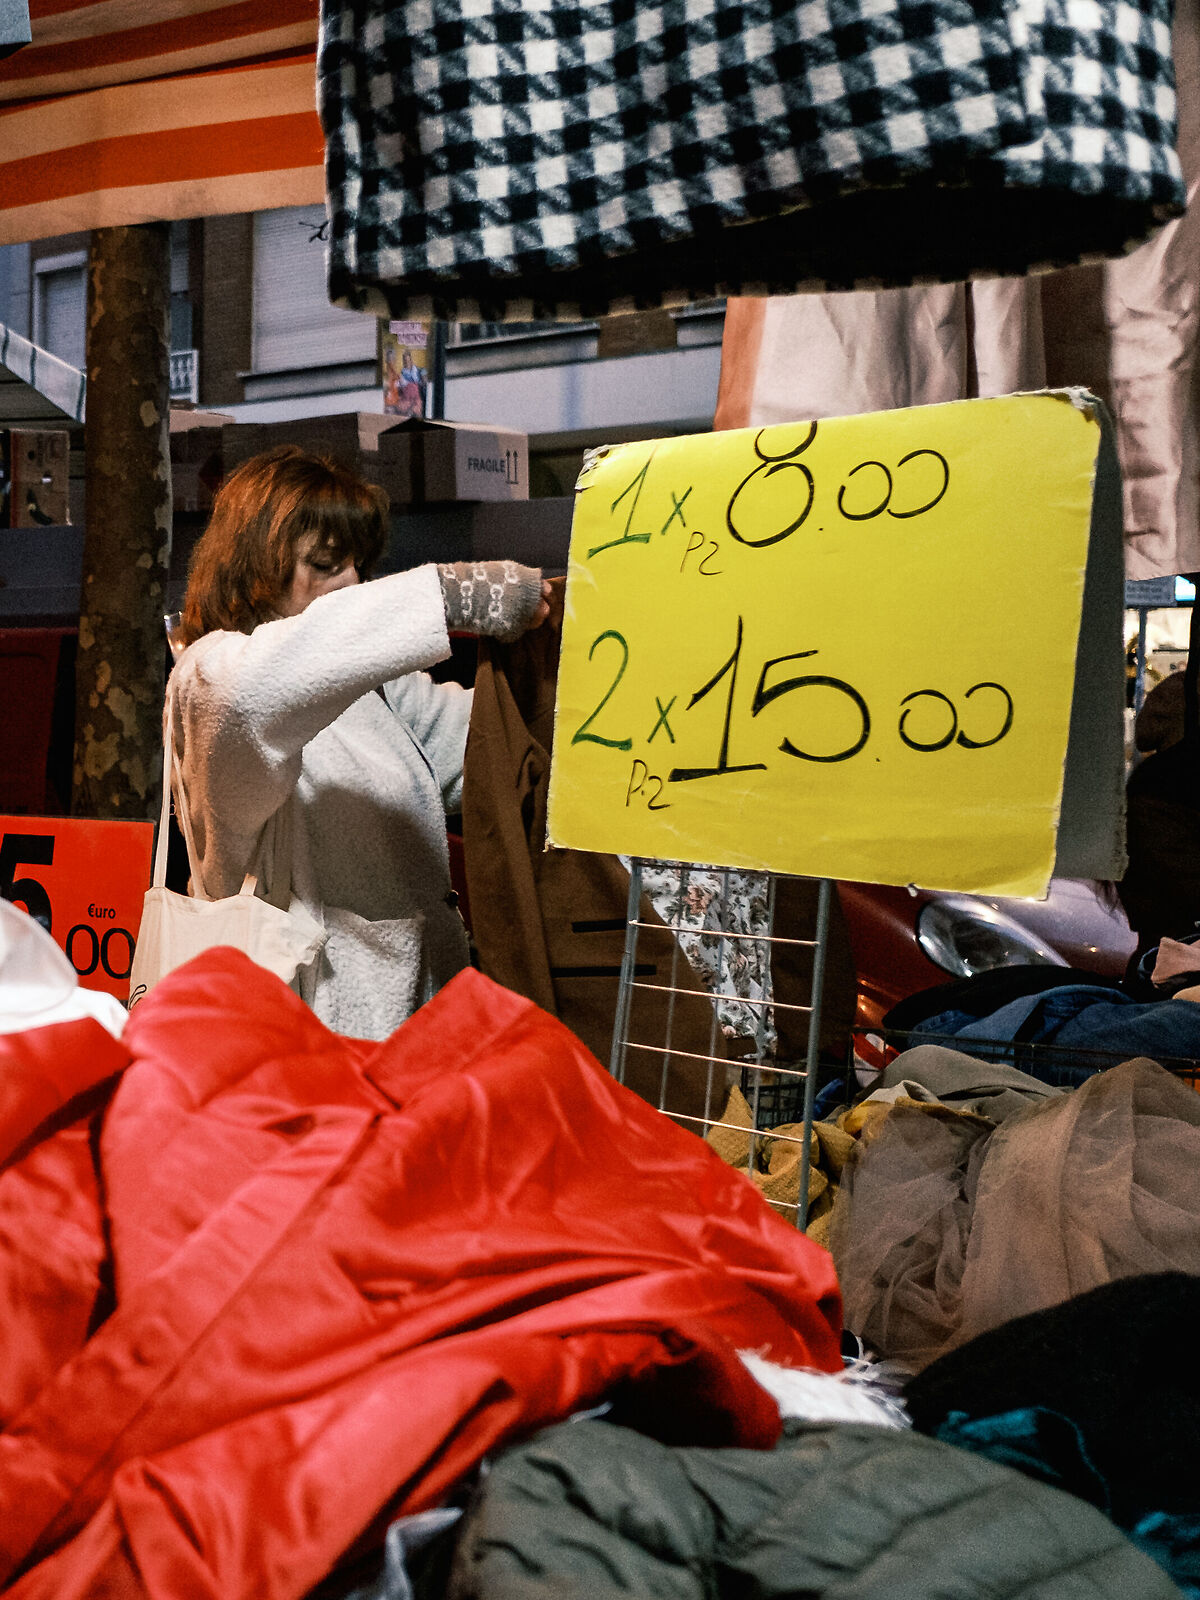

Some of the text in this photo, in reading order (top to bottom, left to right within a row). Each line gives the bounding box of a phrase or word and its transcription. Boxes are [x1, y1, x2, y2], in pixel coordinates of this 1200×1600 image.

[467, 457, 506, 473] FRAGILE
[87, 903, 117, 920] €uro
[65, 924, 137, 980] 00
